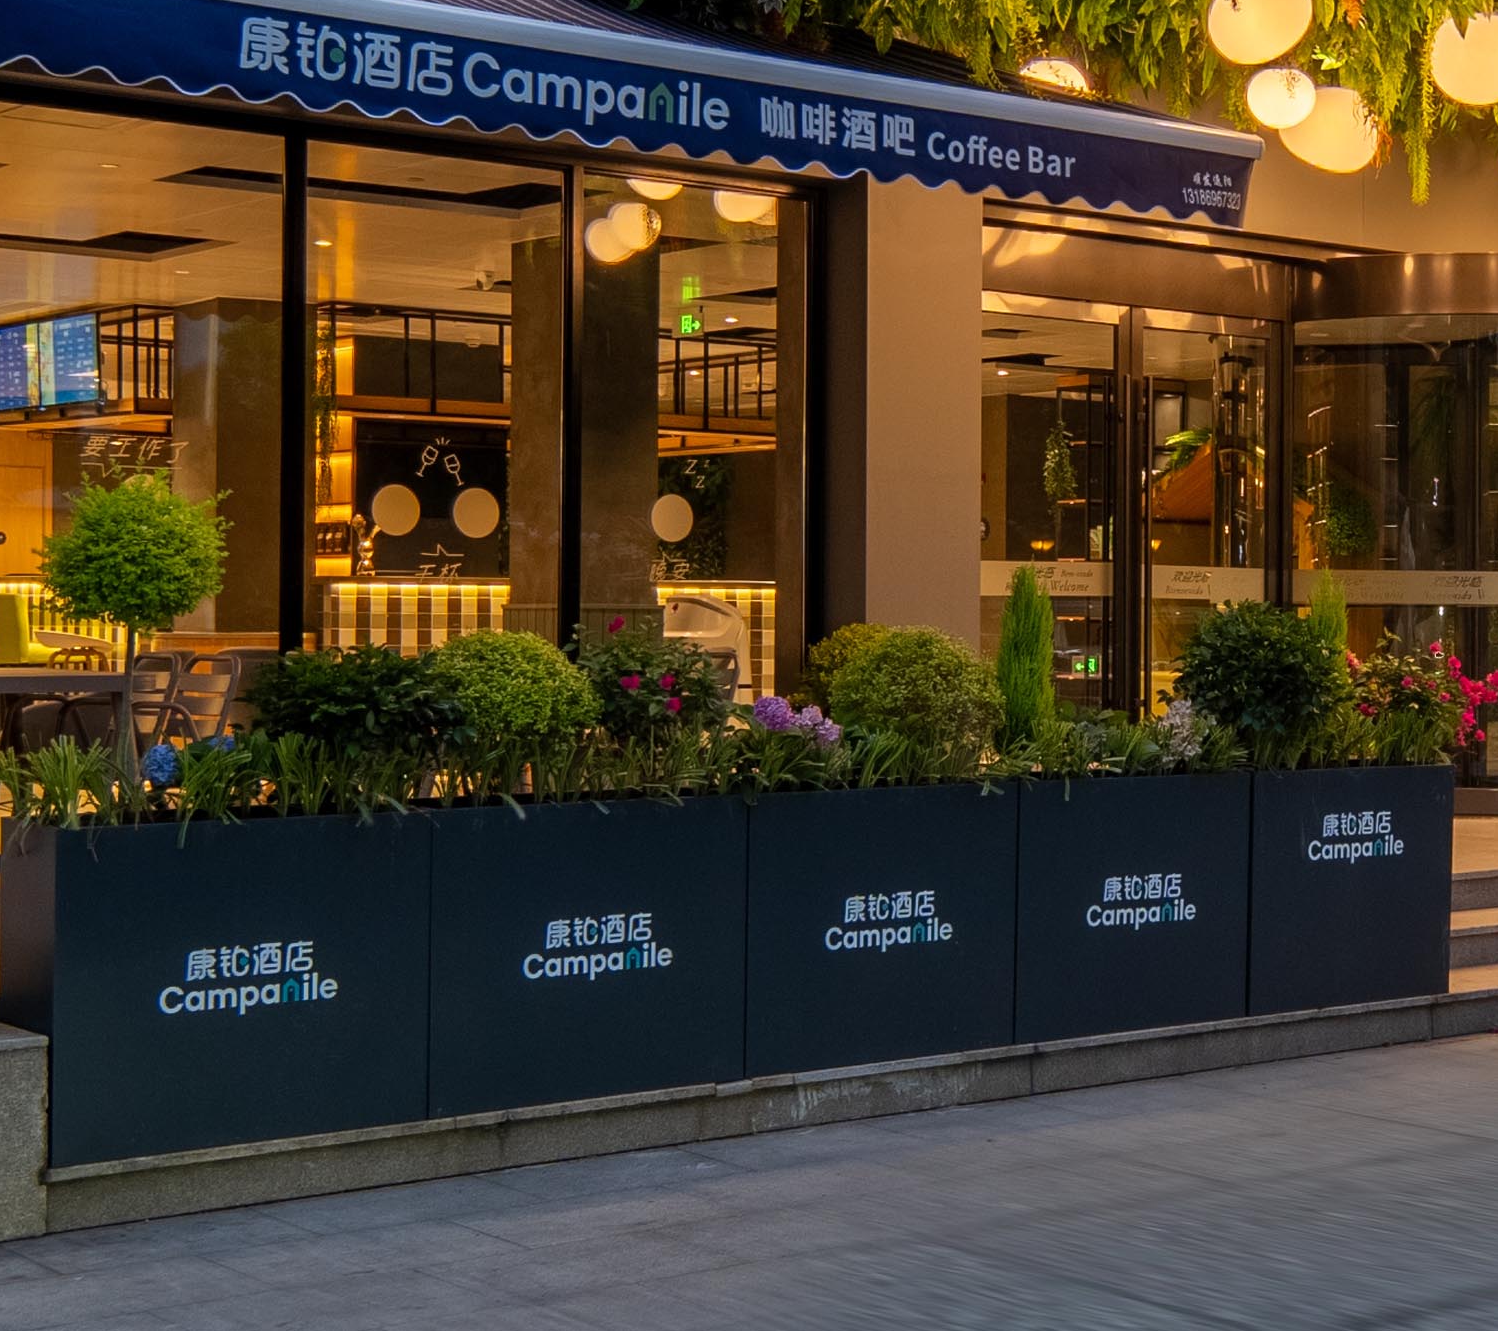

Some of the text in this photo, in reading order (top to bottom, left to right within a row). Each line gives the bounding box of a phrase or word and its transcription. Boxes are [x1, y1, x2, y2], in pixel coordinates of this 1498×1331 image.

[239, 17, 1076, 178] 康铂酒店 Campanile 咖啡酒吧 Coffee Bar
[1323, 811, 1391, 837] 康铂酒店
[1308, 834, 1404, 864] Campanile
[1103, 873, 1182, 902] 康铂酒店
[844, 890, 935, 923] 康铂酒店
[1086, 898, 1196, 930] Campanile
[546, 913, 652, 949] 康铂酒店
[825, 917, 953, 953] Campanile
[186, 941, 314, 982] 康铂酒店
[522, 942, 673, 981] Campanile
[159, 972, 339, 1016] Campanile
